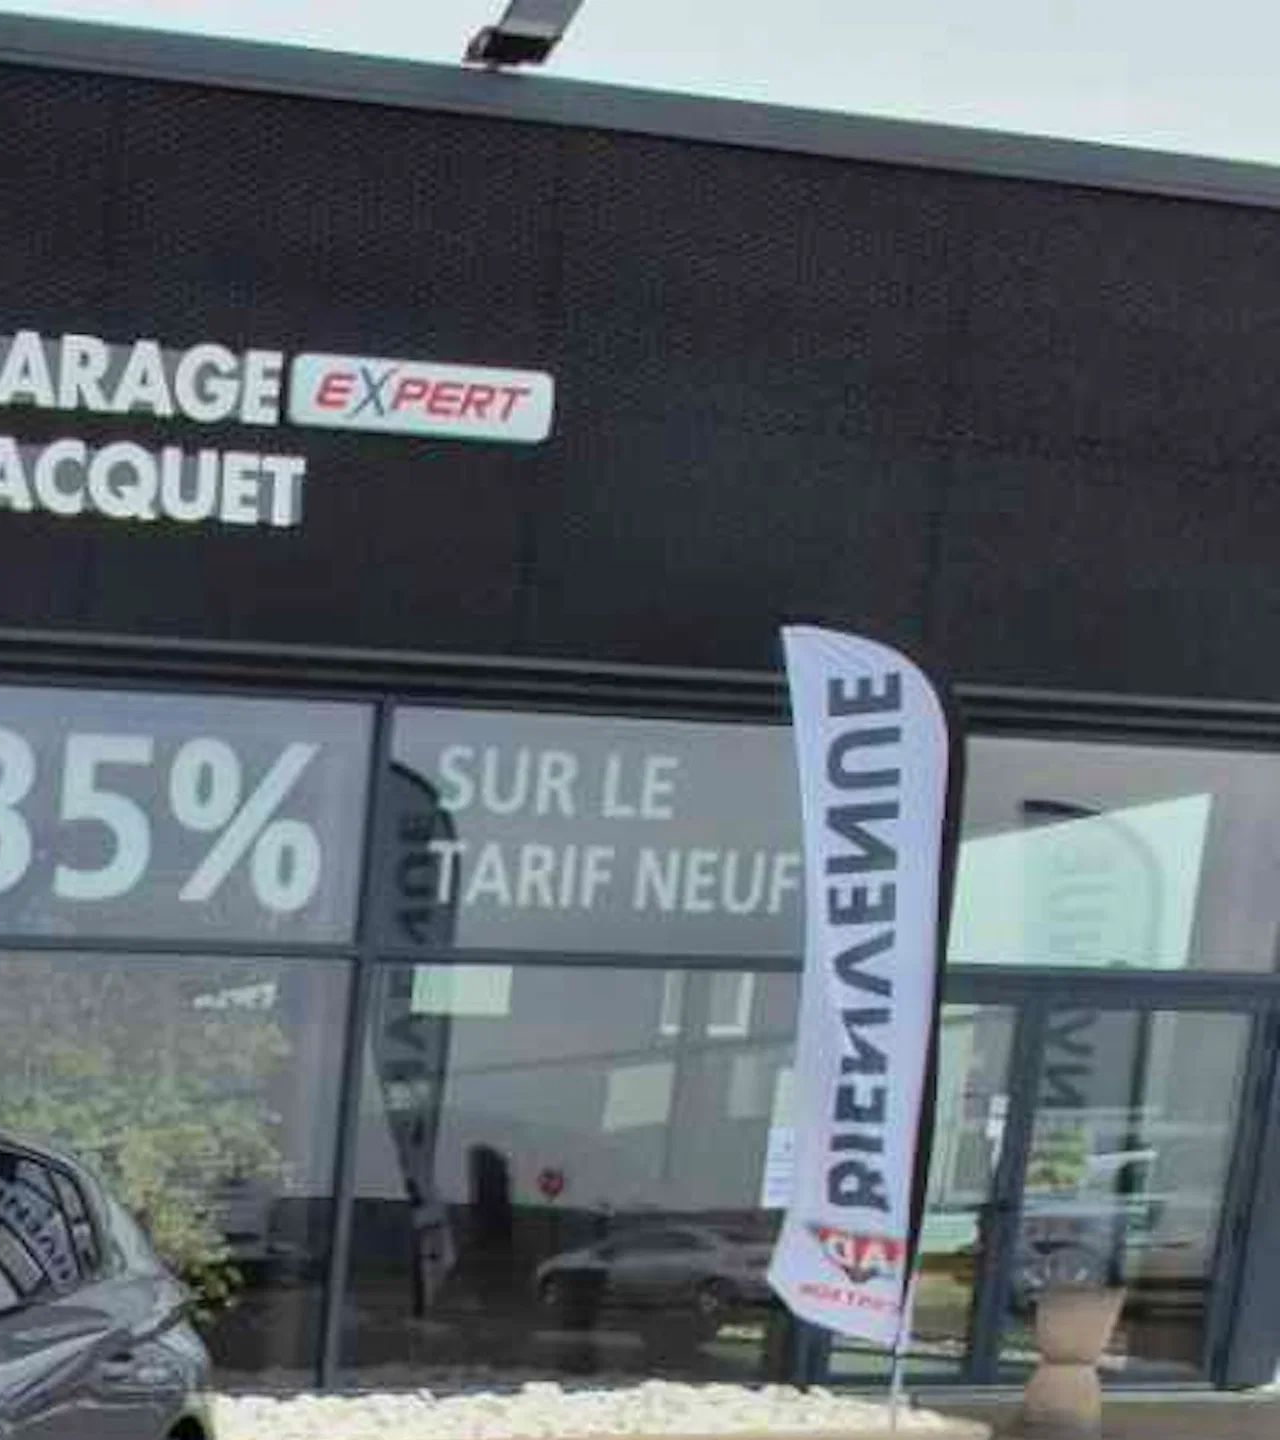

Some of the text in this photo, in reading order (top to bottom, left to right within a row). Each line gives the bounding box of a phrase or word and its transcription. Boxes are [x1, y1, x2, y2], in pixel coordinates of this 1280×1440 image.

[438, 744, 679, 820] SUR LE
[428, 838, 801, 914] TARIF NEUF
